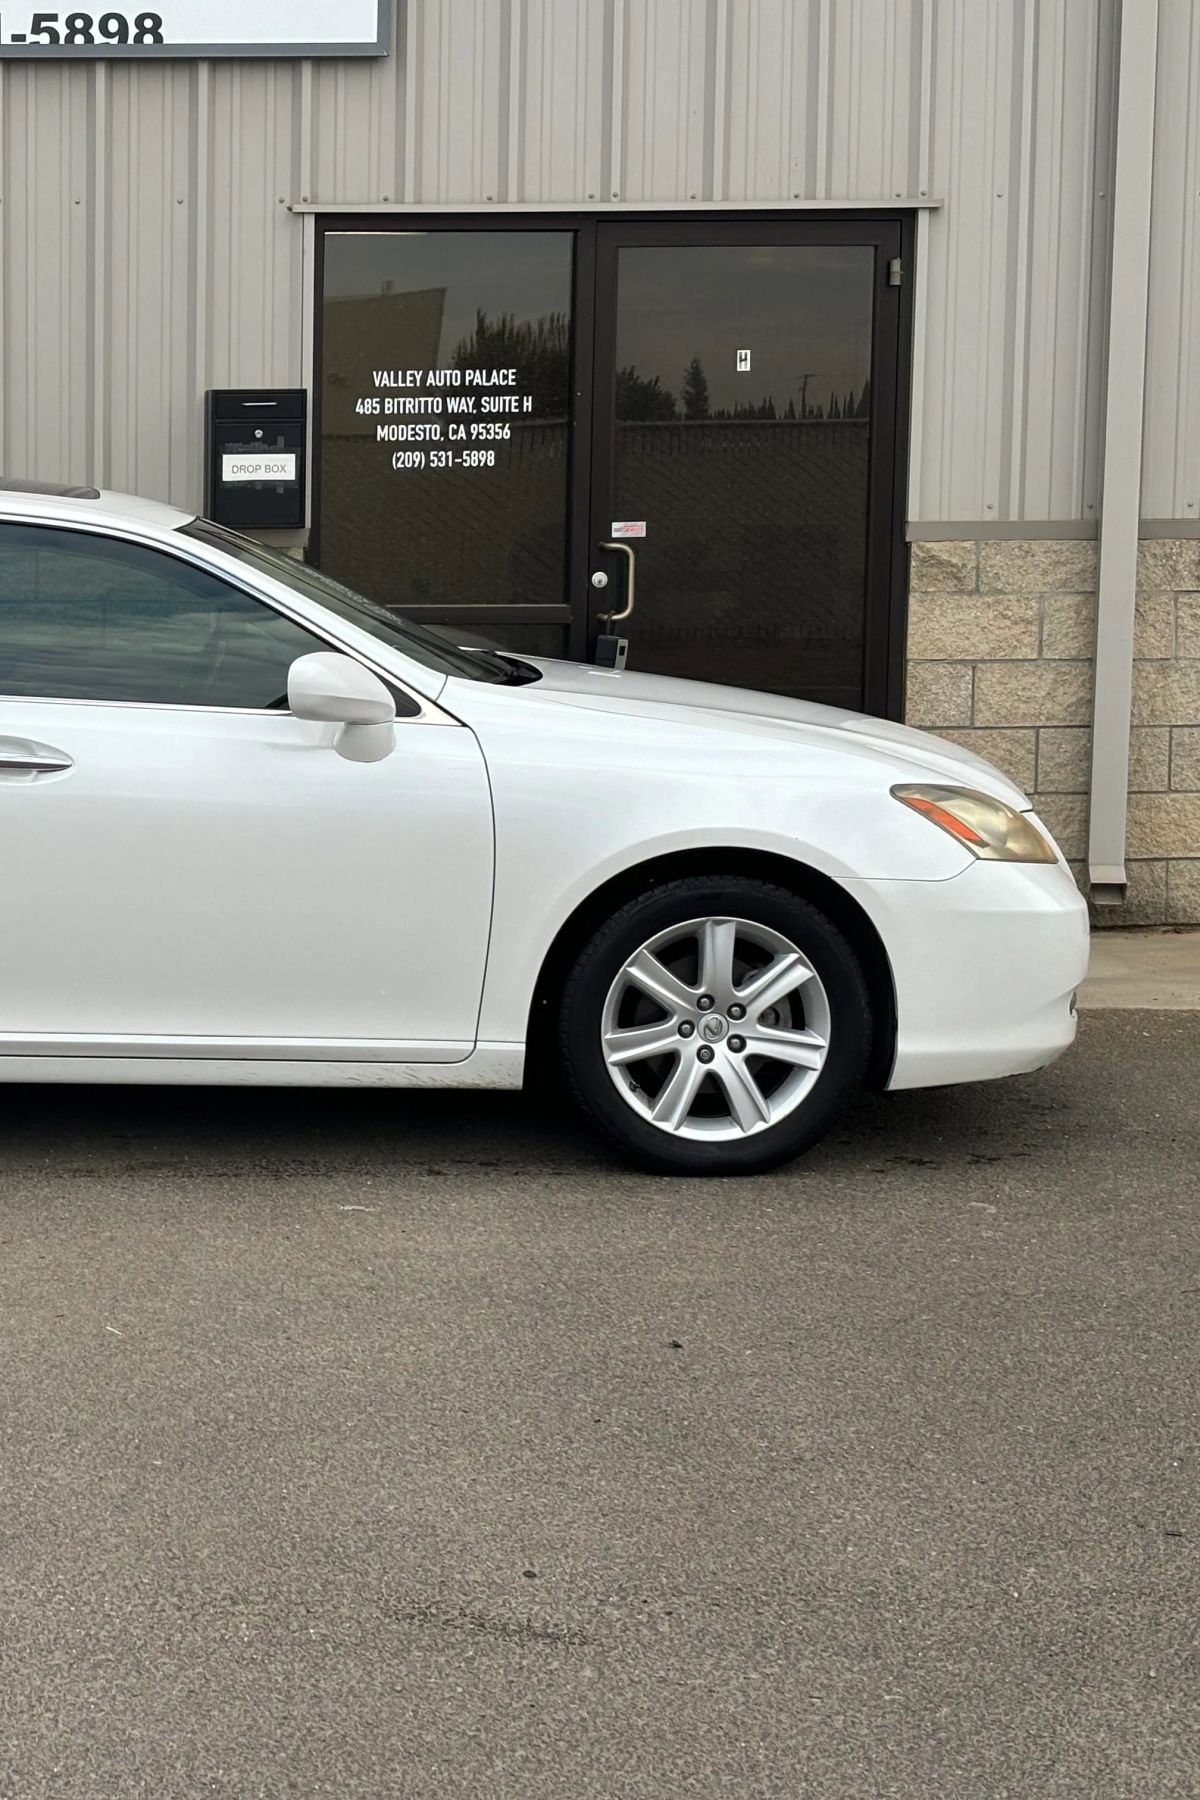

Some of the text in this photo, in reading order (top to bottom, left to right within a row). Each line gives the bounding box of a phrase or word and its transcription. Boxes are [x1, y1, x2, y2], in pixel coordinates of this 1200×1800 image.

[372, 368, 517, 388] VALLEY AUTO PALACE
[355, 395, 533, 415] 485 BITRITTO WAY, SUITE H
[376, 423, 511, 442] MODESTO, CA 95356
[231, 464, 287, 474] DROP BOX
[392, 450, 495, 470] (209) 531-5898
